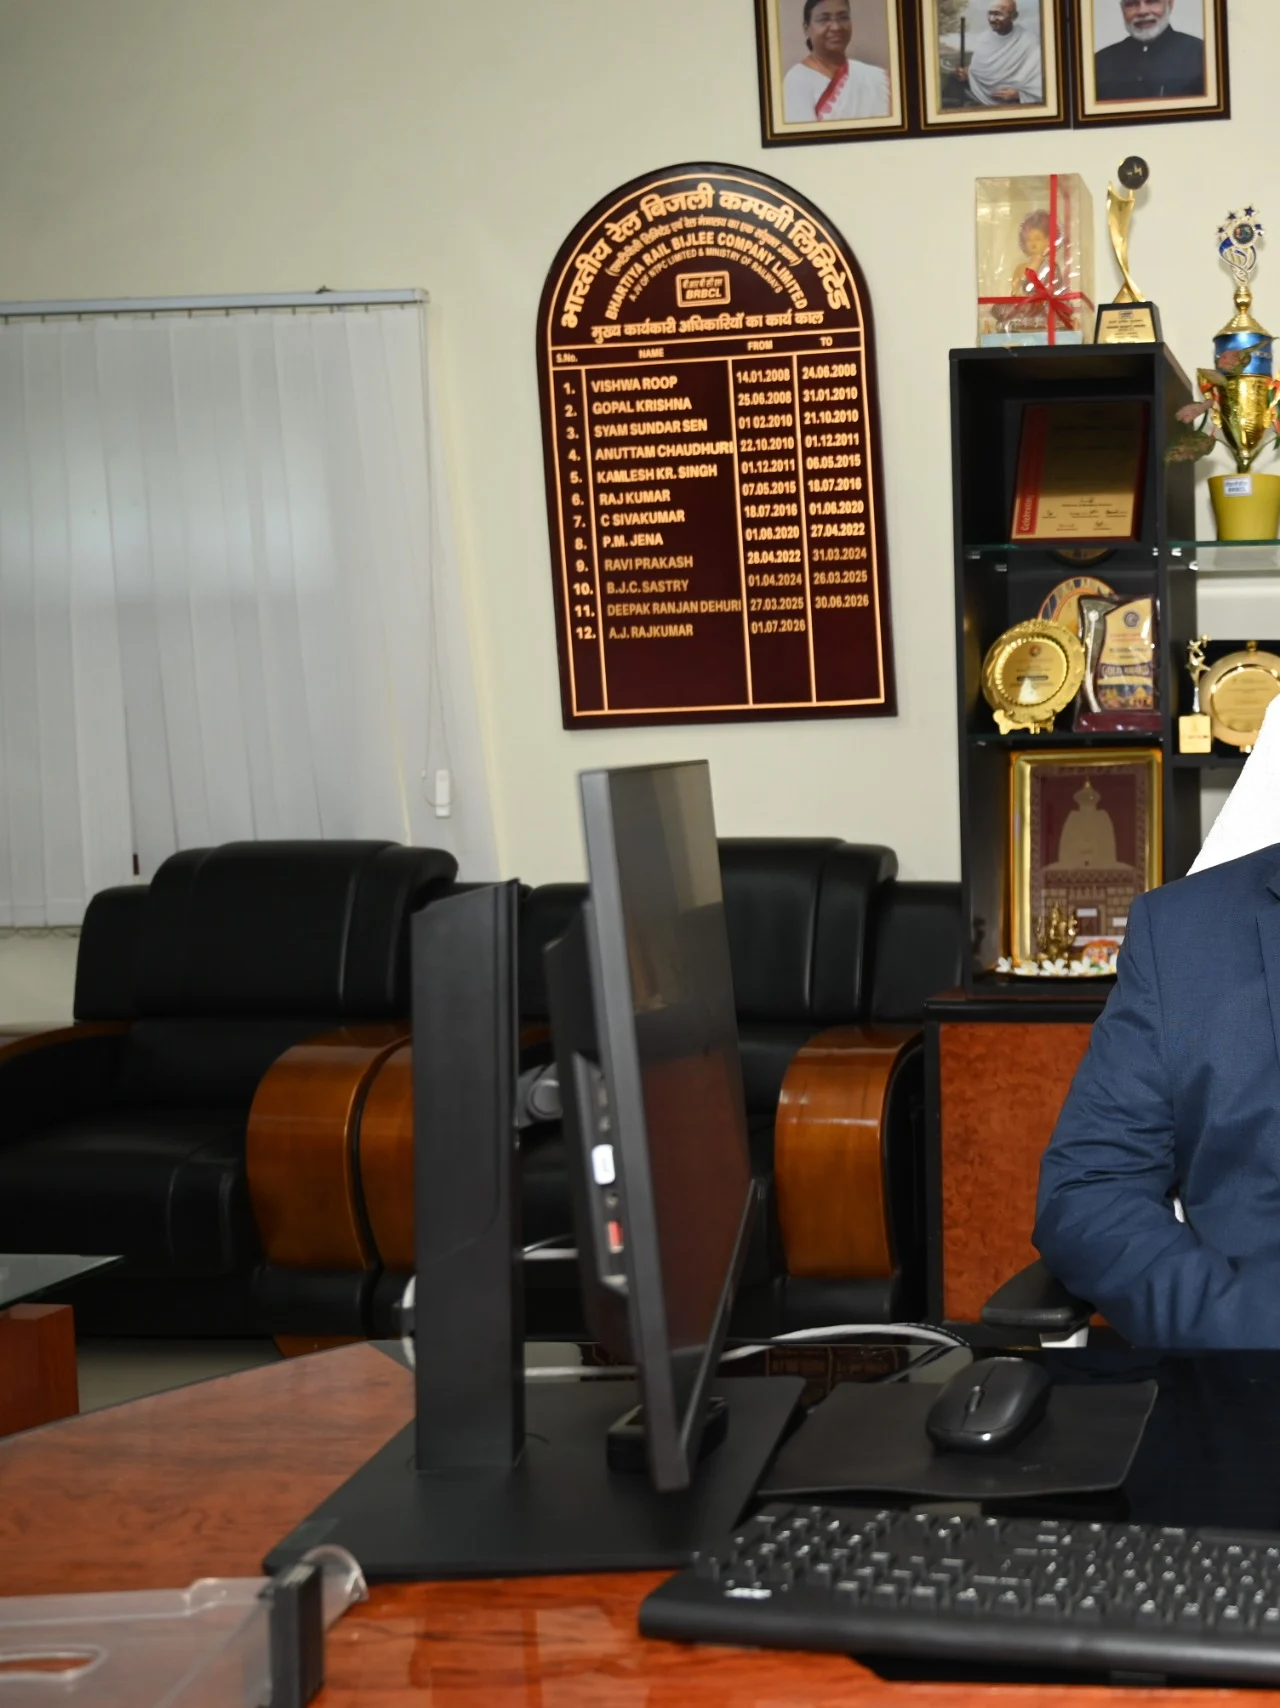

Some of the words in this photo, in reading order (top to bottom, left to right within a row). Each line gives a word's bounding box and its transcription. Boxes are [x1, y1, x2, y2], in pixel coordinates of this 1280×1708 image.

[561, 237, 613, 329] भारतीय
[604, 210, 642, 243] रेल
[640, 182, 715, 222] बिजली
[719, 190, 795, 232] कम्पनी
[787, 219, 851, 310] लिमिटेड
[604, 262, 646, 321] BHARTIYA
[642, 243, 671, 267] RAIL
[671, 231, 715, 251] BIJLEE
[717, 231, 776, 266] COMPANY
[771, 260, 808, 310] LIMITED
[641, 274, 650, 287] OF
[649, 260, 669, 278] NTPC
[667, 248, 697, 266] LIMITED
[698, 247, 705, 257] &
[705, 247, 742, 262] MINISTRY
[740, 255, 752, 266] OF
[751, 261, 784, 294] RAILWAYS
[685, 288, 722, 300] BRBCL
[590, 324, 621, 344] मुख्य
[624, 316, 676, 336] कार्यकारी
[678, 313, 743, 333] अधिकारियों
[746, 315, 763, 329] का
[765, 309, 792, 327] कार्य
[794, 311, 824, 326] काल
[638, 348, 664, 359] NAME
[747, 340, 773, 351] FROM
[820, 336, 833, 347] TO
[563, 382, 576, 395] 1.
[590, 378, 641, 393] VISHWA
[642, 375, 678, 390] ROOP
[736, 368, 790, 384] 14.01.2008
[802, 363, 857, 380] 24.06.2008
[564, 404, 578, 418] 2.
[592, 401, 635, 415] GOPAL
[636, 397, 693, 413] KRISHNA
[737, 391, 792, 406] 25.06.2008
[803, 387, 858, 402] 31.01.2010
[566, 427, 579, 440] 3.
[594, 424, 628, 438] SYAM
[629, 421, 681, 436] SUNDAR
[682, 418, 708, 432] SEN
[804, 409, 859, 425] 21.10.2010
[568, 449, 581, 461] 4.
[595, 445, 656, 461] ANUTTAM
[657, 440, 733, 458] CHAUDHURI
[740, 437, 795, 453] 22.10.2010
[805, 433, 859, 448] 01.12.2011
[570, 471, 583, 484] 5.
[596, 468, 655, 484] KAMLESH
[656, 467, 677, 480] KR.
[678, 464, 718, 478] SINGH
[741, 458, 796, 474] 01.12.2011
[806, 454, 861, 470] 06.05.2015
[571, 493, 584, 506] 6.
[599, 492, 624, 506] RAJ
[625, 489, 671, 504] KUMAR
[742, 481, 797, 496] 07.05.2015
[807, 477, 862, 493] 18.07.2016
[573, 515, 586, 528] 7.
[601, 514, 610, 527] C
[613, 509, 685, 526] SIVAKUMAR
[744, 503, 798, 518] 18.07.2016
[809, 500, 864, 516] 01.06.2020
[574, 537, 587, 550] 8.
[602, 534, 628, 548] P.M.
[631, 532, 664, 547] JENA
[745, 525, 799, 541] 01.06.2020
[810, 522, 865, 538] 27.04.2022
[575, 559, 589, 572] 9.
[604, 558, 633, 571] RAVI
[635, 556, 694, 570] PRAKASH
[747, 549, 801, 565] 28.04.2022
[812, 547, 867, 562] 31.03.2024
[573, 582, 594, 596] 10.
[606, 581, 641, 595] B.J.C.
[642, 579, 689, 593] SASTRY
[748, 573, 802, 587] 01.04.2024
[813, 570, 868, 585] 26.03.2025
[574, 604, 595, 618] 11.
[607, 603, 651, 617] DEEPAK
[652, 601, 699, 615] RANJAN
[700, 599, 742, 613] DEHURI
[750, 597, 805, 611] 27.03.2025
[576, 626, 597, 640] 12.
[608, 626, 630, 639] A.J.
[631, 623, 694, 639] RAJKUMAR
